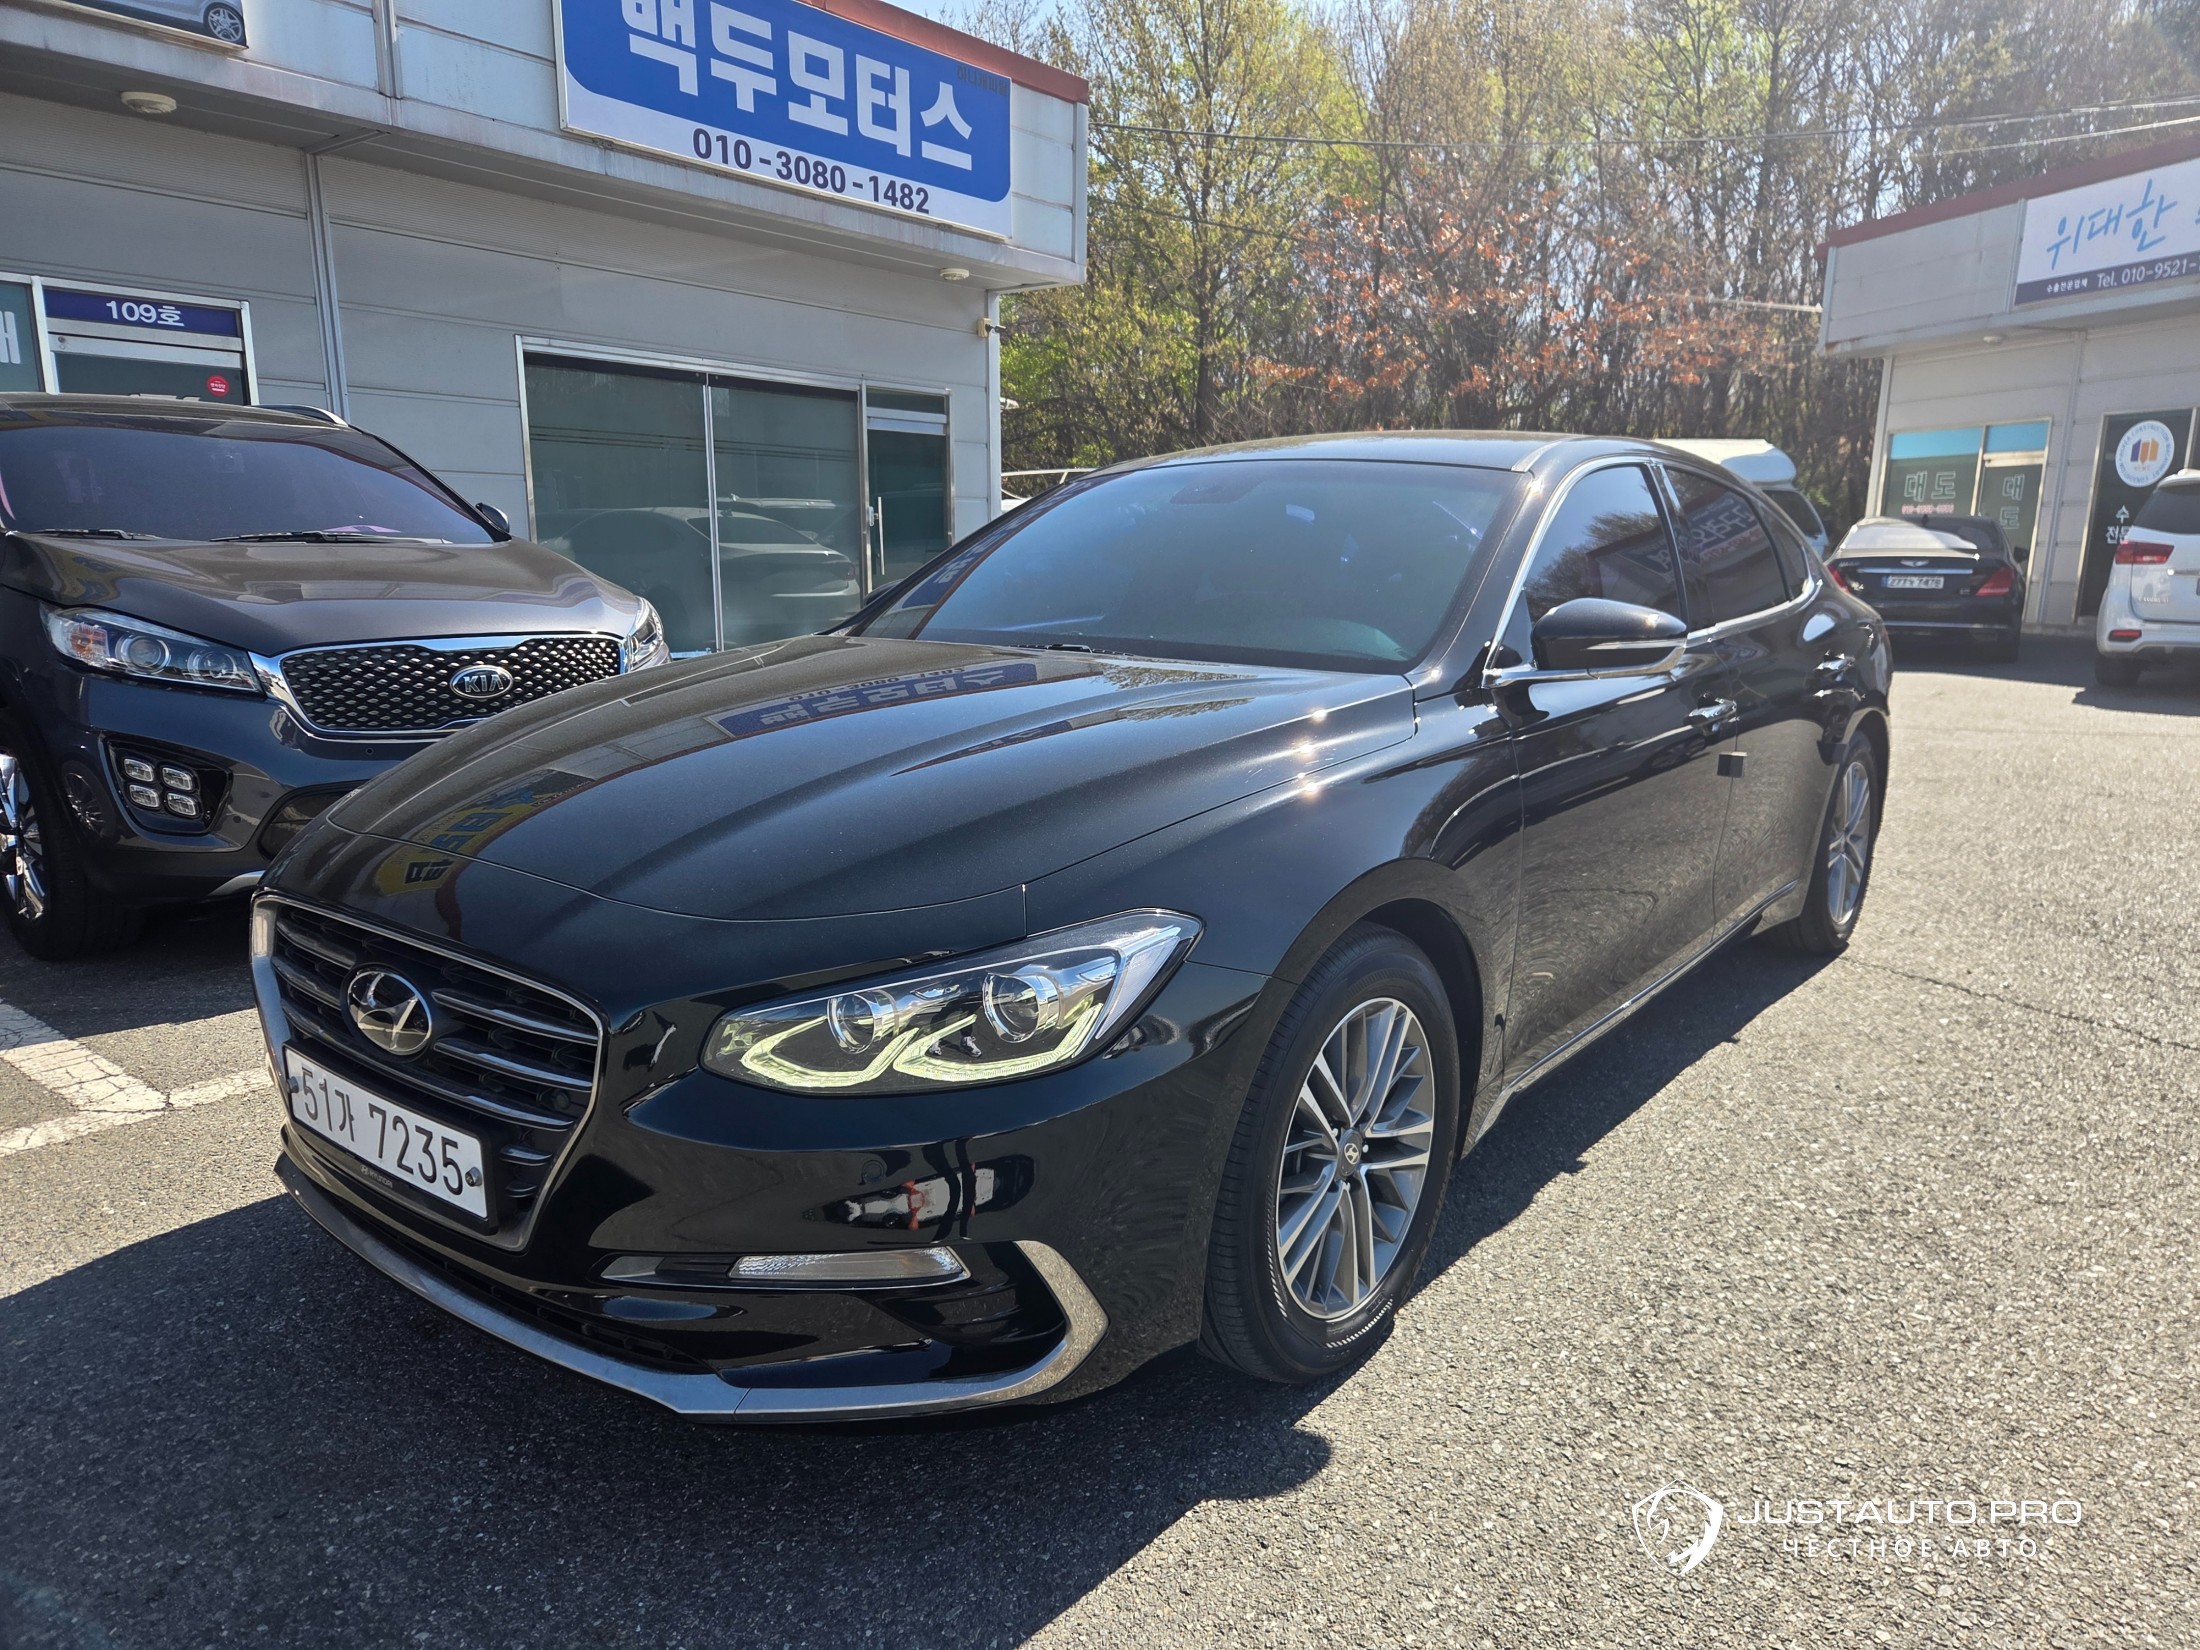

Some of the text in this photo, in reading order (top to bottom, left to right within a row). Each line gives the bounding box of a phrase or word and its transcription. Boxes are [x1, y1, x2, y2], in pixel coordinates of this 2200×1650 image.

[621, 0, 972, 171] 백두모터스
[692, 128, 930, 215] 010-3080-1482
[2046, 178, 2178, 271] 위대한
[106, 300, 185, 327] 109호
[2096, 271, 2118, 288] Tel.
[2121, 255, 2200, 284] 010-9521-
[463, 674, 504, 693] KIA
[301, 1066, 463, 1196] 51가 7235
